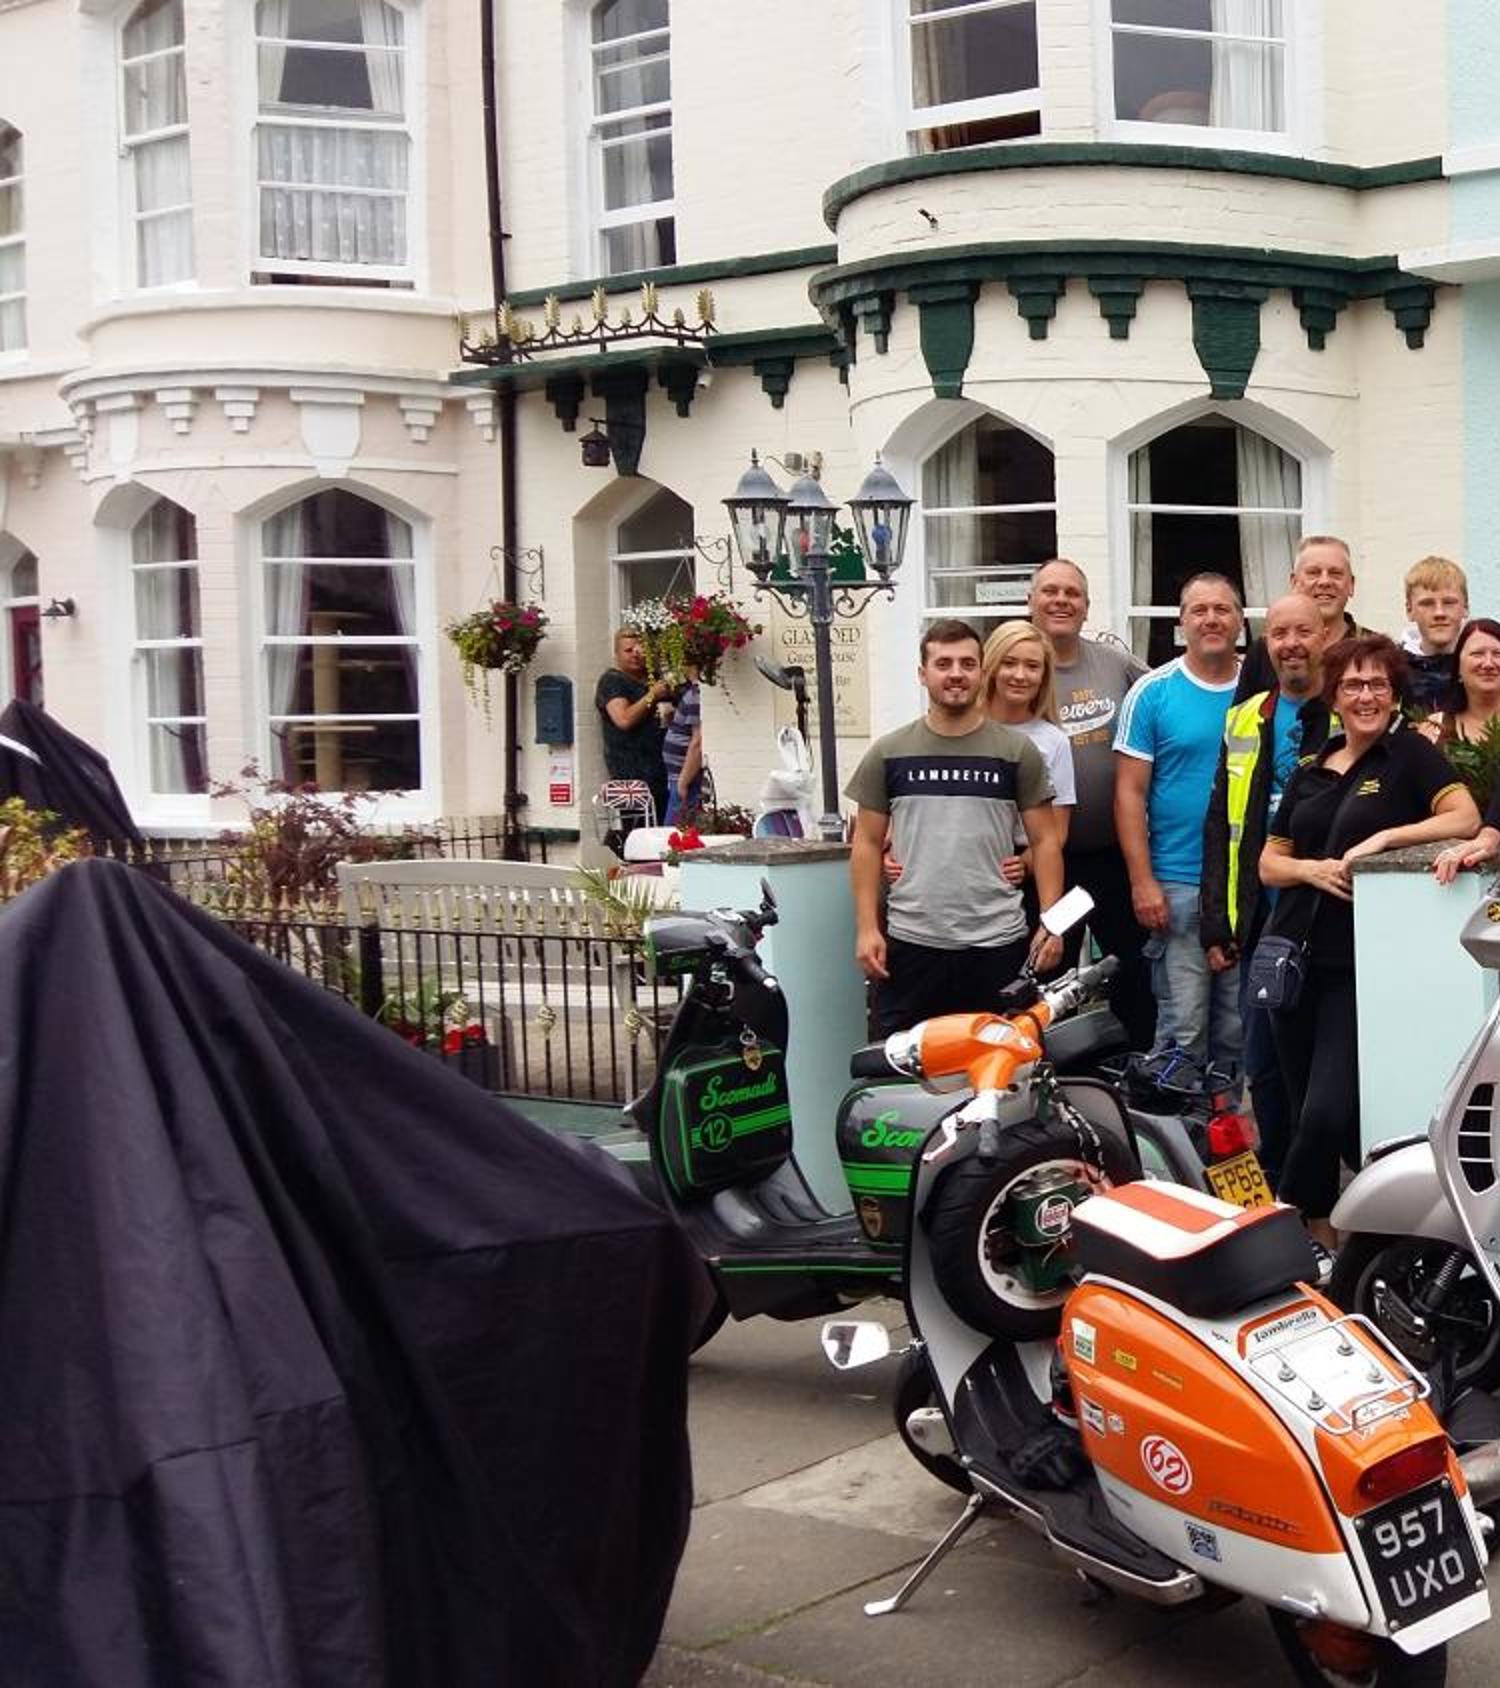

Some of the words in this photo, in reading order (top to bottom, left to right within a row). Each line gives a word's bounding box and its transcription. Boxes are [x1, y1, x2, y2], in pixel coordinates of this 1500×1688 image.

[908, 769, 1000, 783] LAMBRETTA
[703, 1117, 727, 1147] 12
[1211, 1159, 1263, 1200] FP66
[1151, 1439, 1184, 1492] 62
[1374, 1498, 1444, 1559] 957
[1389, 1548, 1466, 1607] UXO
